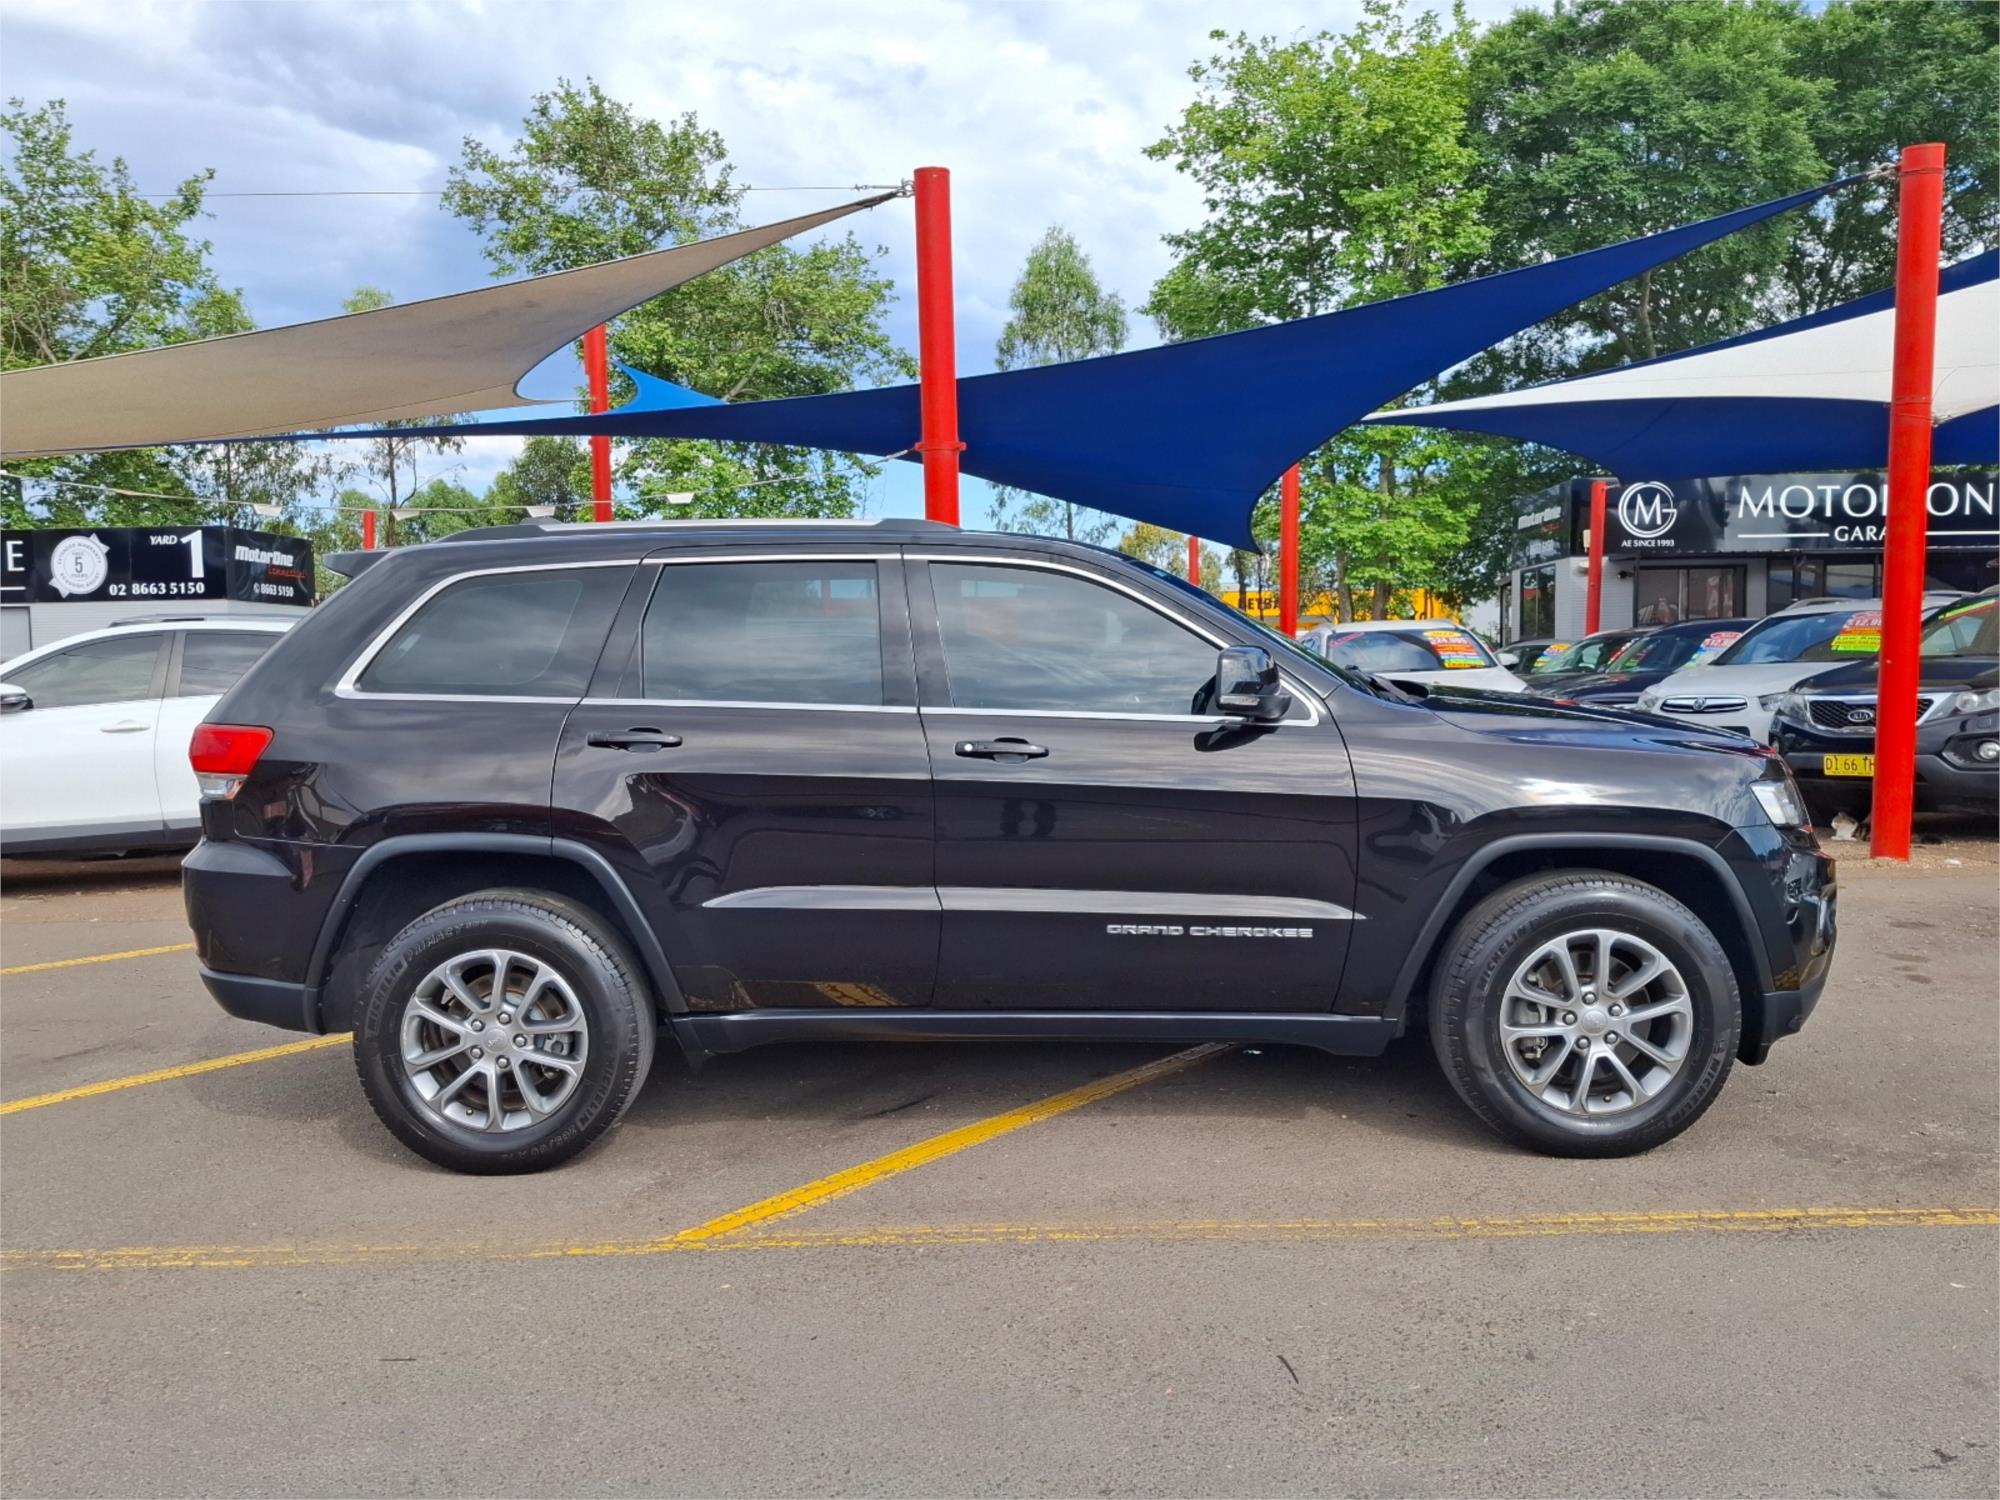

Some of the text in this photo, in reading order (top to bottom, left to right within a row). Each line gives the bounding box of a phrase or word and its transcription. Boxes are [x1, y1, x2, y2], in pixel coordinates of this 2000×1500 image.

[1738, 484, 1887, 518] MOTO
[1657, 539, 1675, 547] 1993
[150, 529, 204, 578] YARD 1
[75, 556, 83, 573] 5
[109, 581, 205, 596] 02 8663 5150
[260, 583, 294, 597] 8663 5150
[1843, 758, 1858, 771] 66
[1106, 924, 1313, 938] GRAND CHEROKEE
